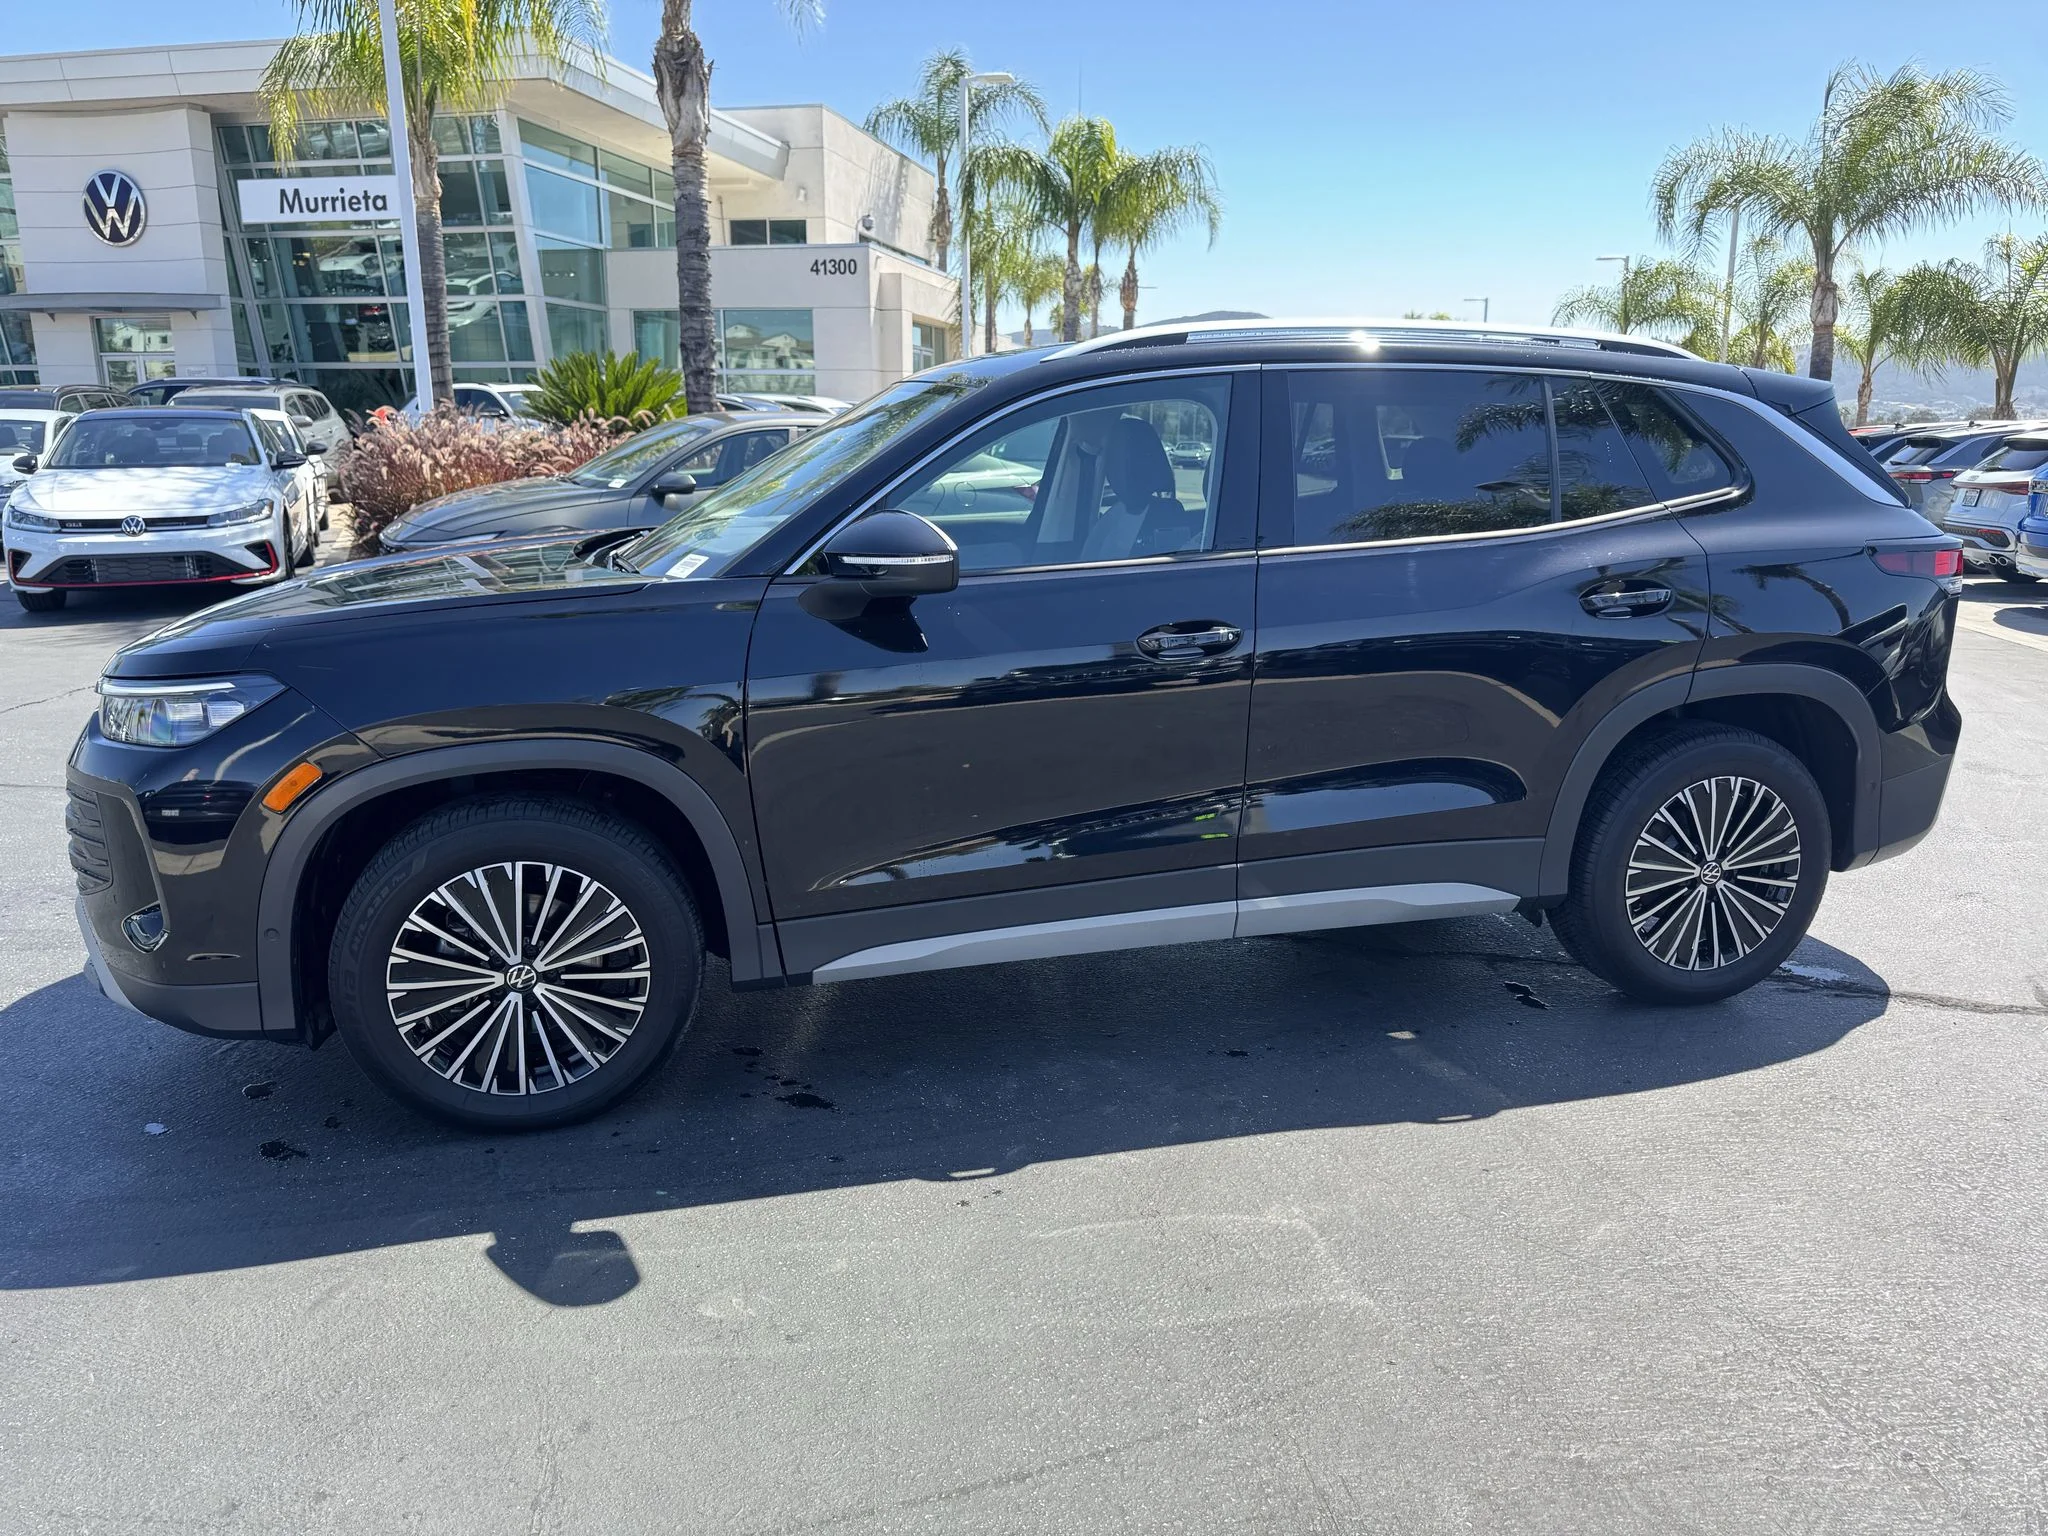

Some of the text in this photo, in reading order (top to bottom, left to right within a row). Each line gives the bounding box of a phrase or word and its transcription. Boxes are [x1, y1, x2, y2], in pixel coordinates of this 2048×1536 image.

[82, 171, 144, 244] VW
[279, 187, 388, 214] Murrieta
[810, 258, 857, 275] 41300
